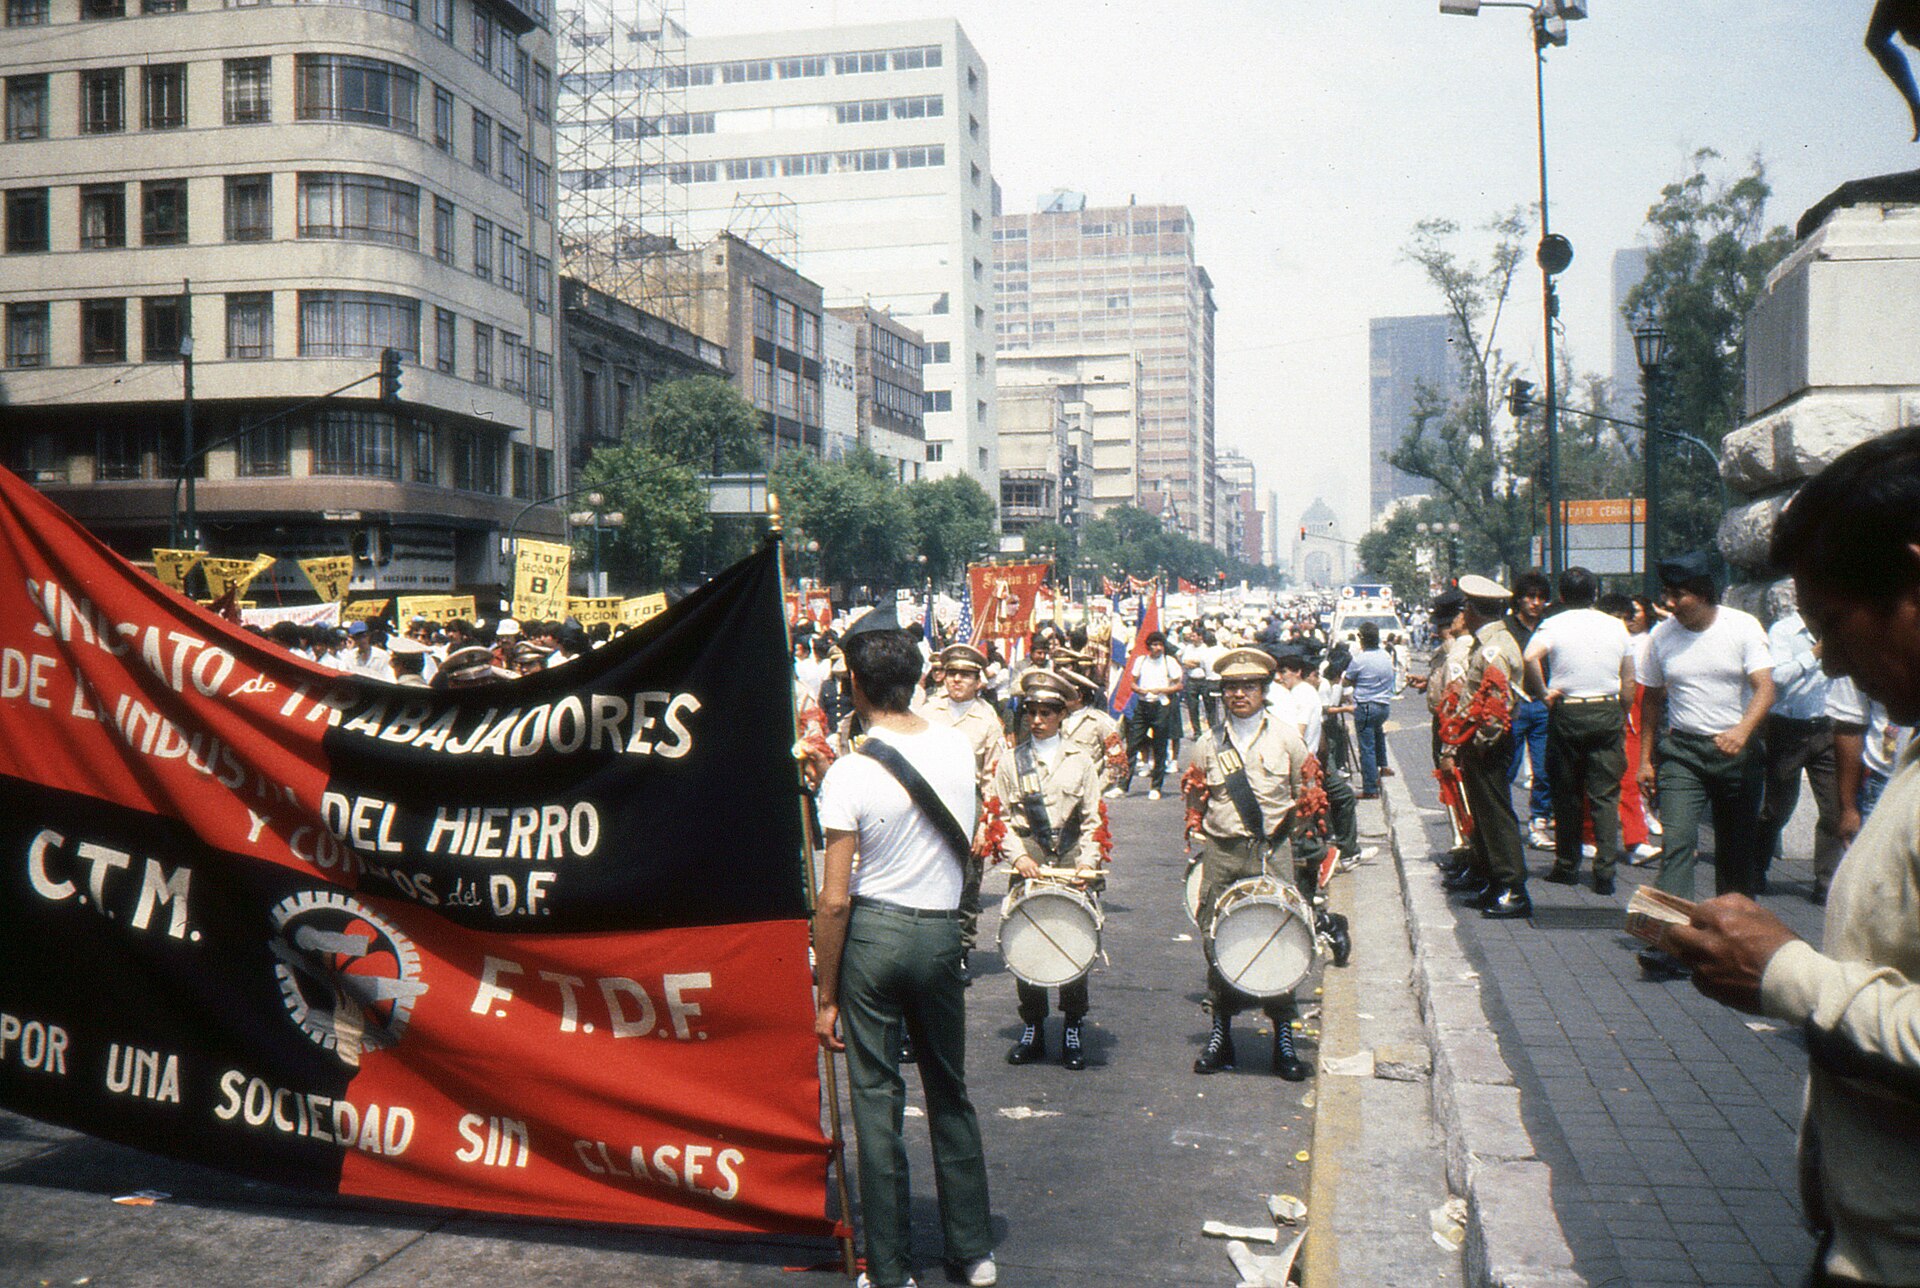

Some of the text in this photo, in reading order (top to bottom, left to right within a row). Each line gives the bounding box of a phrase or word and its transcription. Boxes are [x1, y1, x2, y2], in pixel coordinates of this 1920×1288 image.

[531, 576, 548, 594] B
[228, 671, 276, 698] de
[1, 647, 57, 709] DE
[321, 791, 404, 853] DEL
[425, 800, 601, 860] HIERRO
[247, 808, 272, 843] Y
[489, 870, 558, 917] D.F.
[0, 1012, 745, 1201] POR UNA SOCIEDAD SIN CLASES
